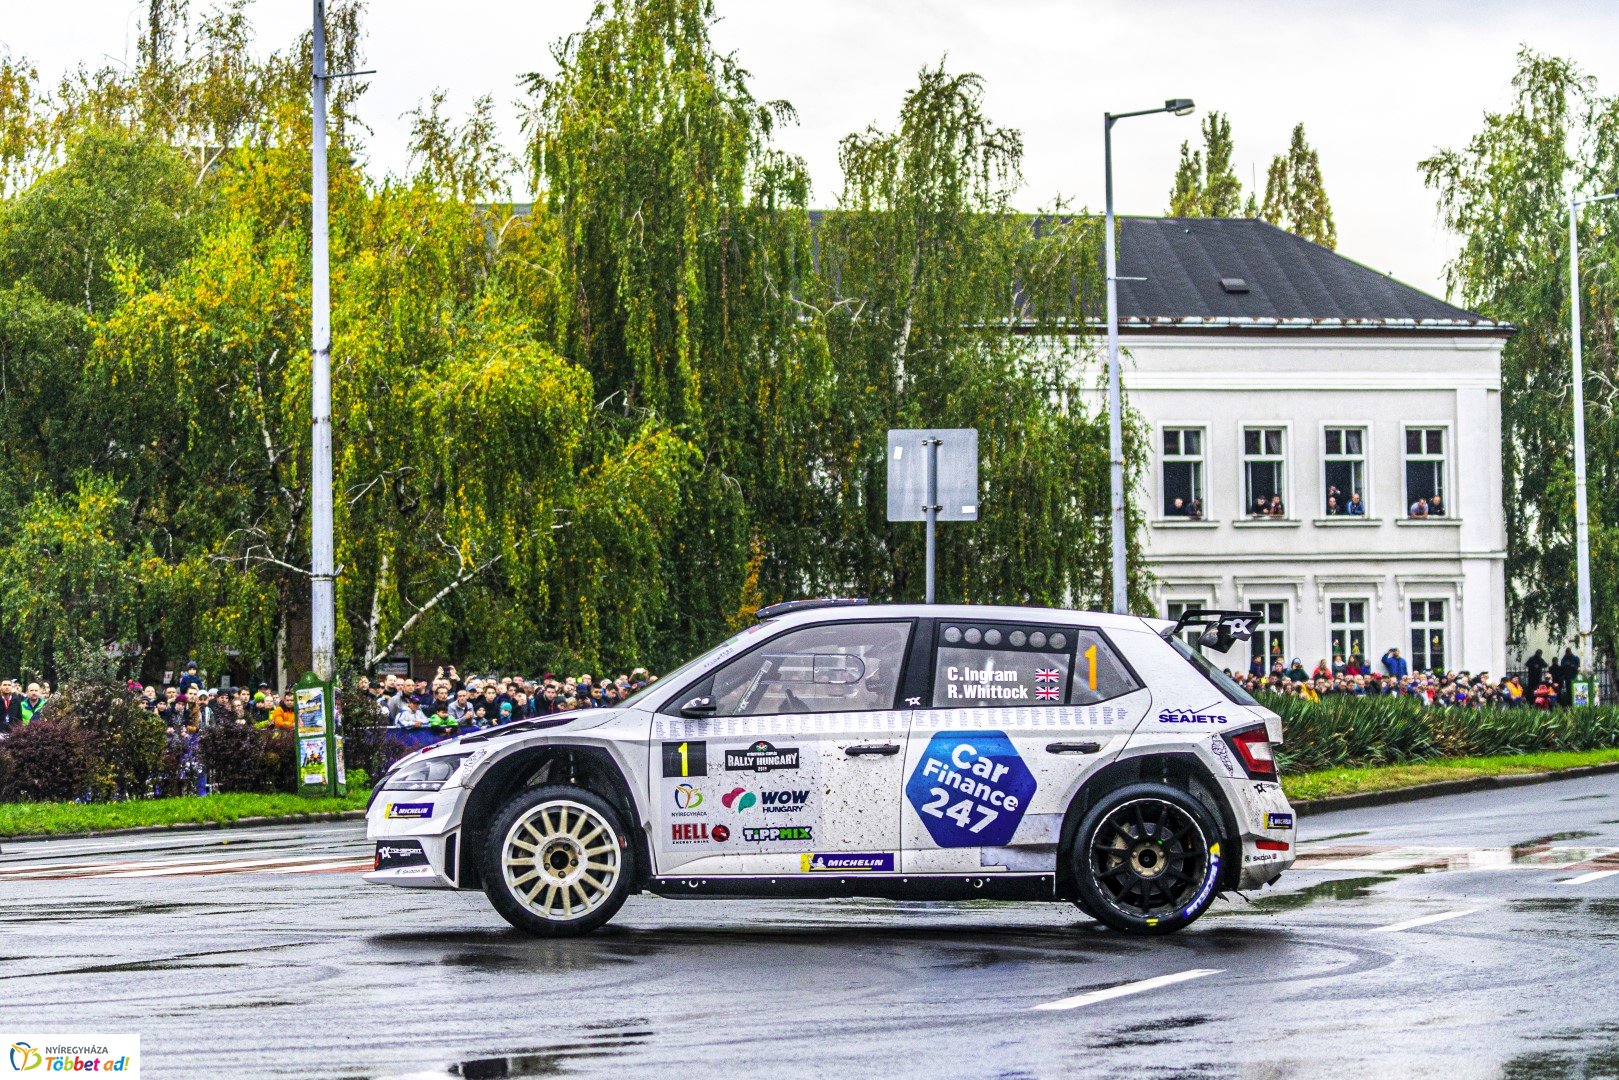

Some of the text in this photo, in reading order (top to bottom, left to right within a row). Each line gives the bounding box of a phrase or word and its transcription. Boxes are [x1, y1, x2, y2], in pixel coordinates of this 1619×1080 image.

[947, 667, 1018, 684] C.Ingram
[1084, 644, 1097, 691] 1
[947, 684, 1028, 699] R.Whittock
[1159, 714, 1227, 723] SEAJETS
[677, 742, 688, 777] 1
[727, 752, 797, 767] RALLY HUNGARY
[952, 744, 1009, 783] Car
[923, 758, 1019, 812] Finance
[762, 791, 810, 804] WOW
[762, 805, 804, 813] HUNGARY
[921, 787, 999, 834] 247
[672, 823, 709, 840] HELL
[827, 859, 883, 867] MICHELIN
